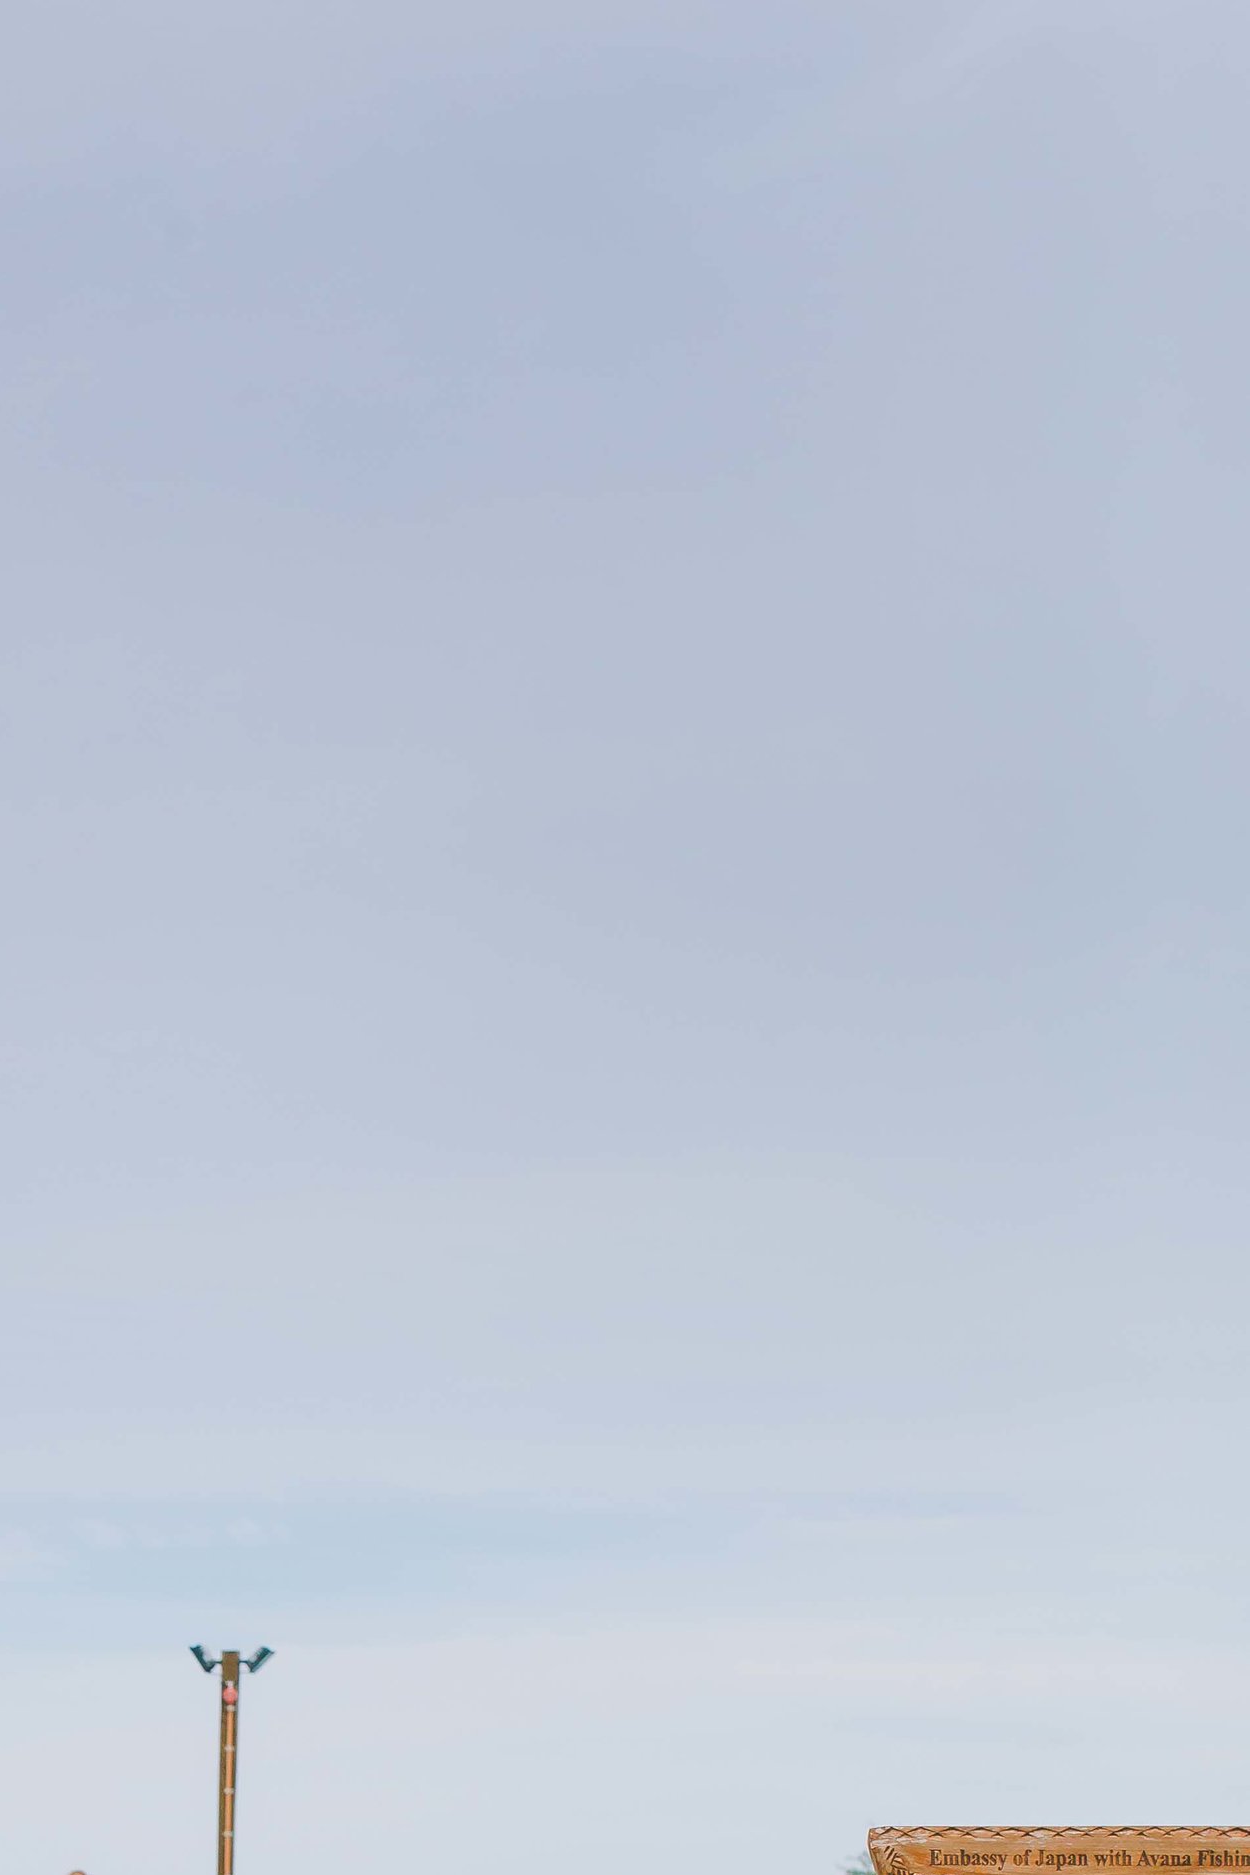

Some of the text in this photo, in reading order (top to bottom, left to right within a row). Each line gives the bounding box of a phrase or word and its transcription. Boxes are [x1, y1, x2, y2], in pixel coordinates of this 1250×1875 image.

[929, 1849, 1007, 1871] Embassy
[1013, 1849, 1033, 1867] of
[1035, 1849, 1088, 1871] Japan
[1094, 1849, 1132, 1867] with
[1136, 1850, 1191, 1867] Avana
